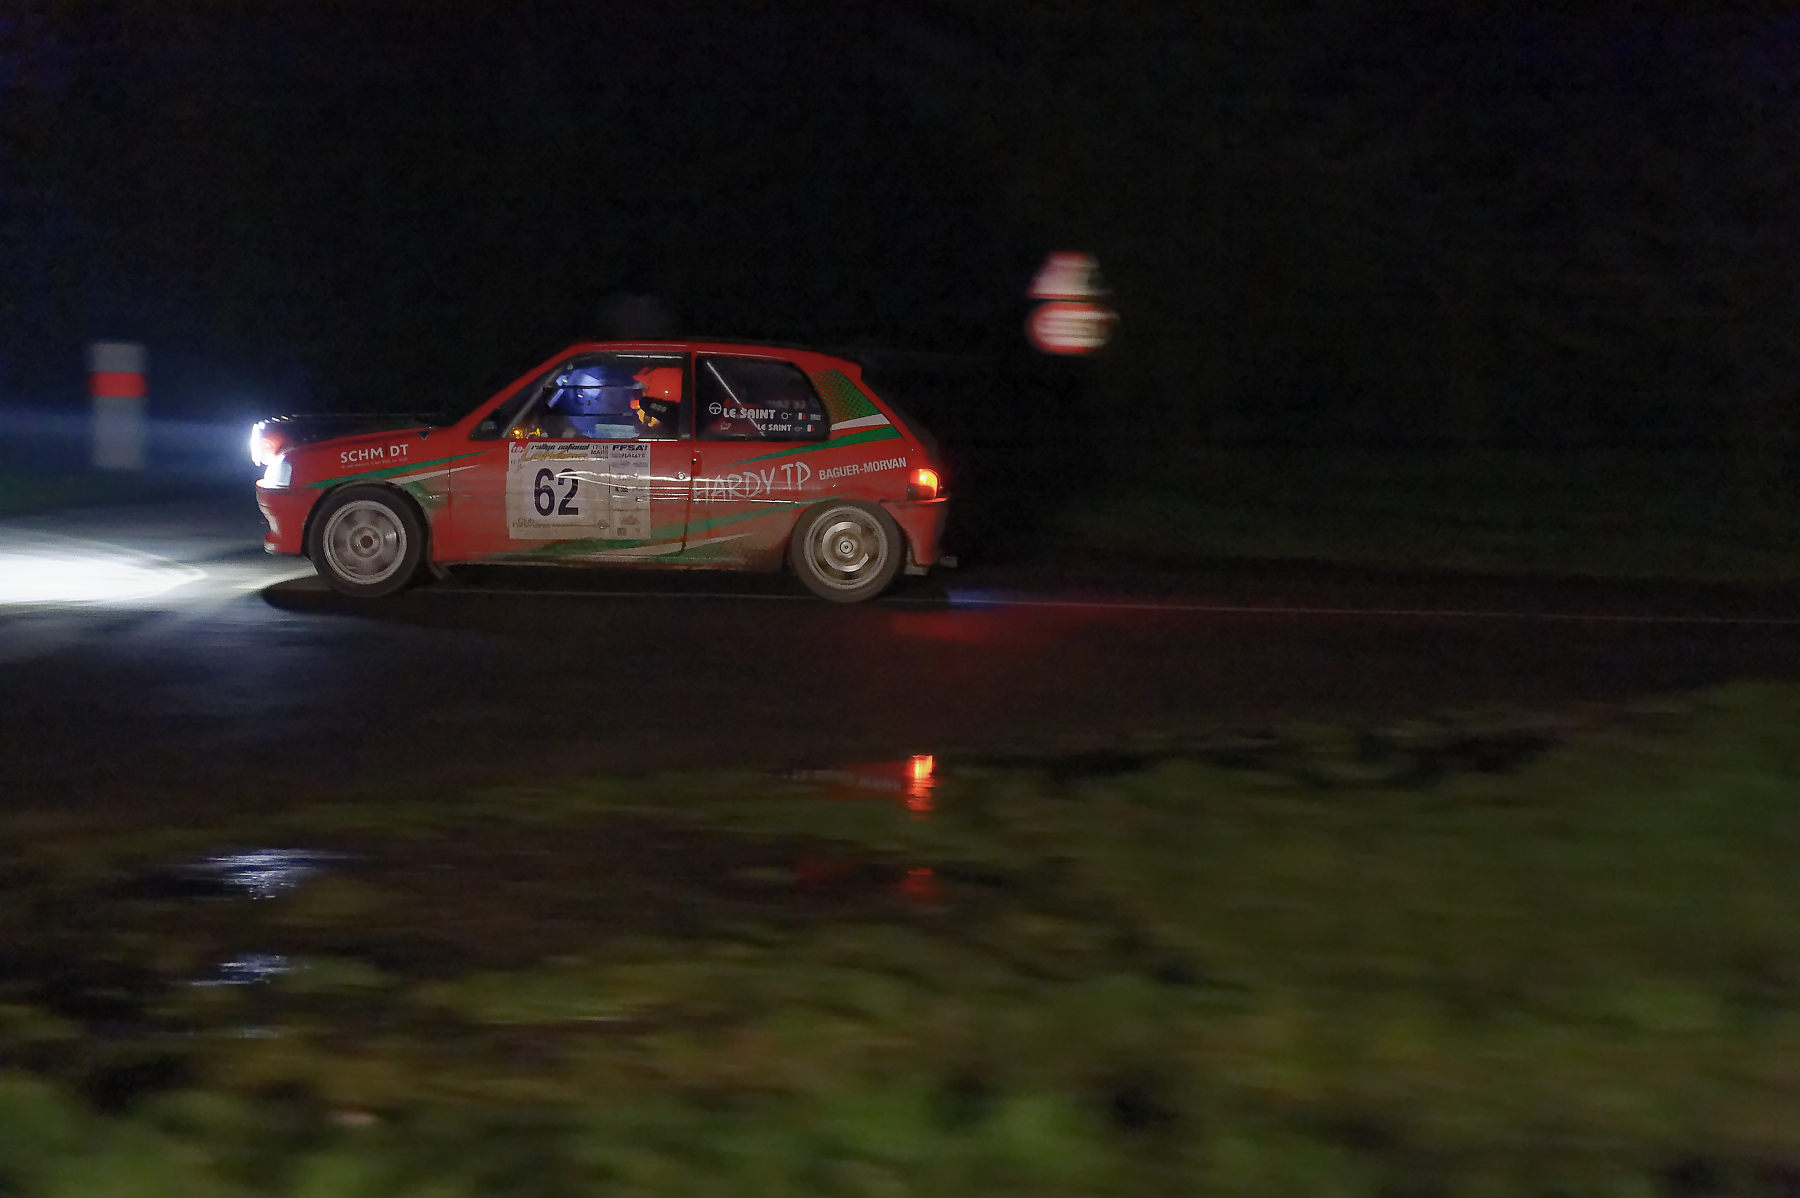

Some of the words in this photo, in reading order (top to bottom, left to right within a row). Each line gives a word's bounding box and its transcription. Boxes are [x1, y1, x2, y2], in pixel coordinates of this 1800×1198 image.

[723, 408, 736, 418] LE
[740, 408, 776, 419] SAINT
[692, 466, 776, 504] HARDY
[781, 461, 811, 491] TP
[818, 456, 907, 481] BAGUER-MORVAN
[534, 467, 579, 516] 62
